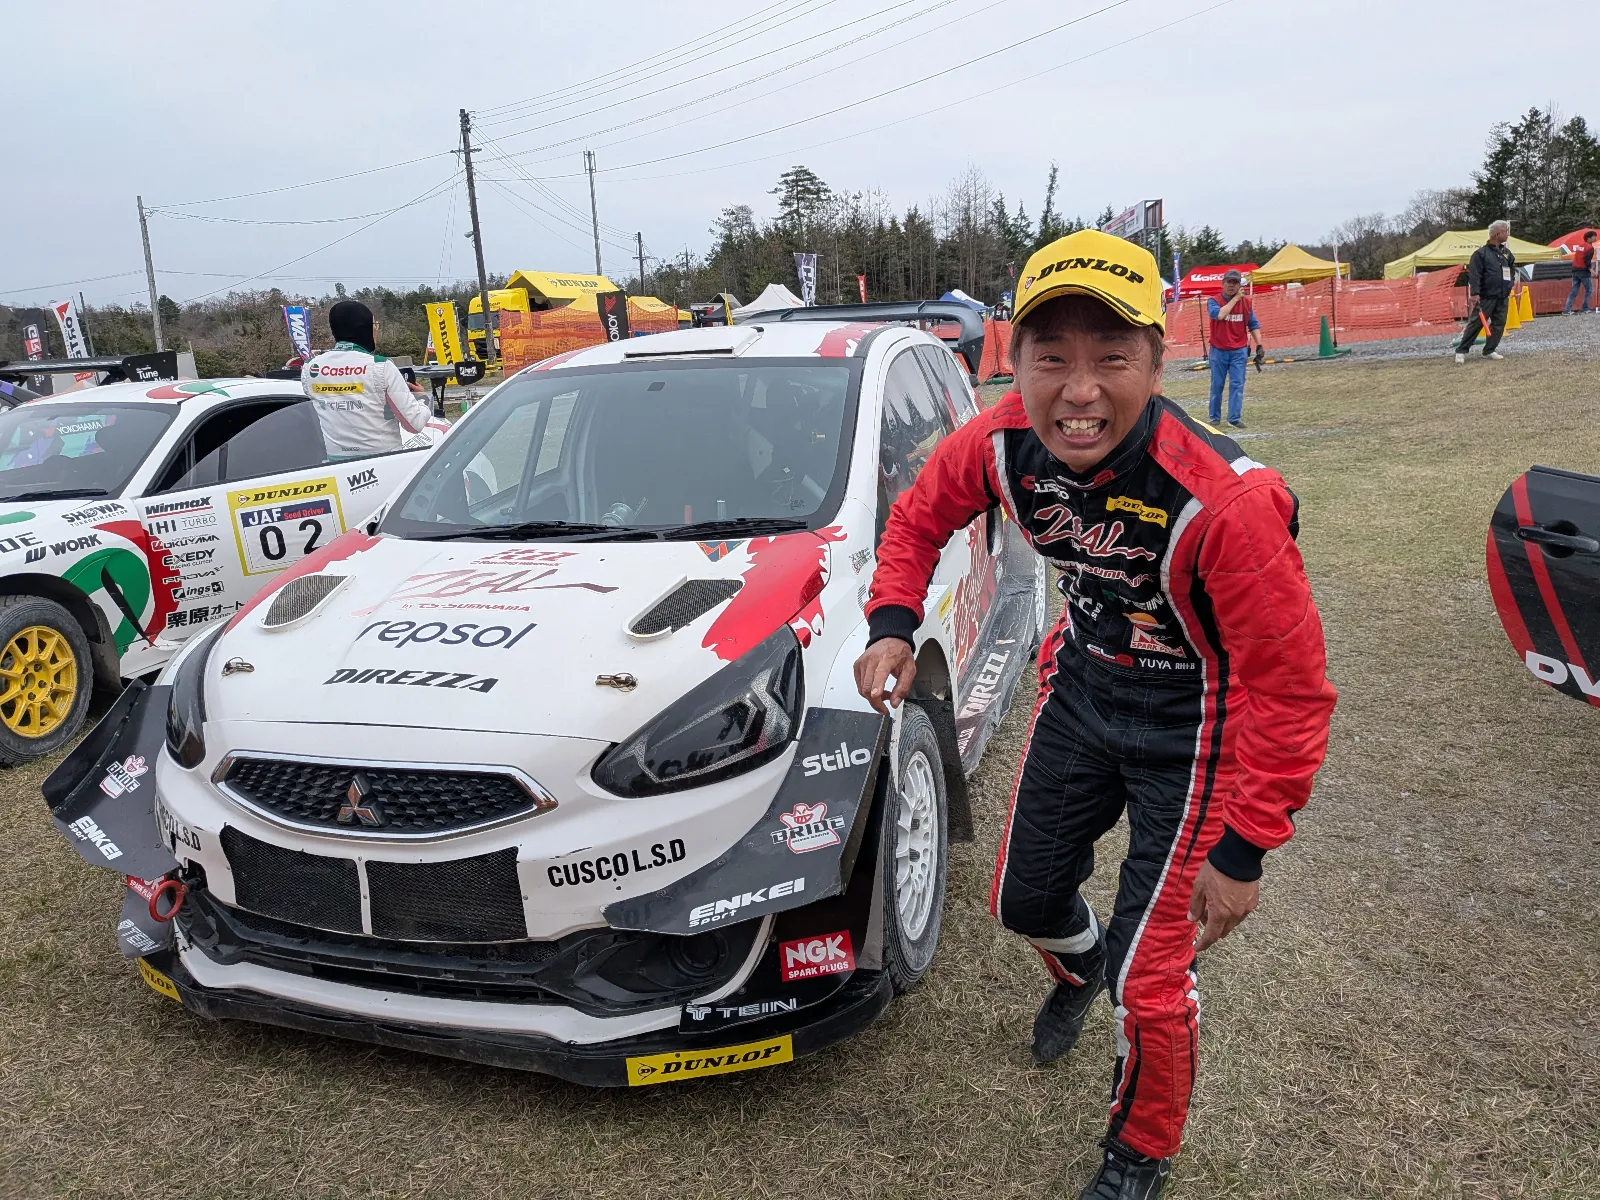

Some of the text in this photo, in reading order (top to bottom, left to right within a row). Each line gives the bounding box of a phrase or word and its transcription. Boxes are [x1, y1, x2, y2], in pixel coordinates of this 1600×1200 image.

[1036, 257, 1144, 285] DUNLOP
[557, 278, 599, 288] DUNLOP
[136, 370, 159, 379] Tune
[320, 365, 368, 377] Castrol
[326, 400, 364, 411] TEIN
[56, 421, 103, 435] YOKOHAMA
[346, 467, 378, 487] WIX
[252, 483, 328, 502] DUNLOP
[60, 502, 125, 523] SHOWA
[144, 496, 212, 515] Winmax
[147, 515, 217, 536] IHI TURBO
[248, 507, 325, 526] JAF Seed Driver
[49, 533, 103, 556] WORK
[163, 548, 216, 566] EXEDY
[353, 620, 538, 649] repsol
[1130, 642, 1158, 651] SPARK
[1138, 657, 1172, 670] YUYA
[322, 668, 500, 694] DIREZZA
[801, 741, 872, 777] Stilo
[106, 760, 141, 793] BRIDE
[67, 822, 88, 842] Sport
[74, 815, 124, 861] ENKEI
[771, 815, 846, 844] BRIDE
[546, 837, 687, 888] CUSCO L.S.D
[688, 877, 806, 920] ENKEI
[688, 908, 738, 929] Sport
[785, 934, 848, 968] NGK
[788, 961, 849, 979] SPARK PLUGS
[715, 997, 797, 1019] TEIN
[660, 1045, 782, 1075] DUNLOP
